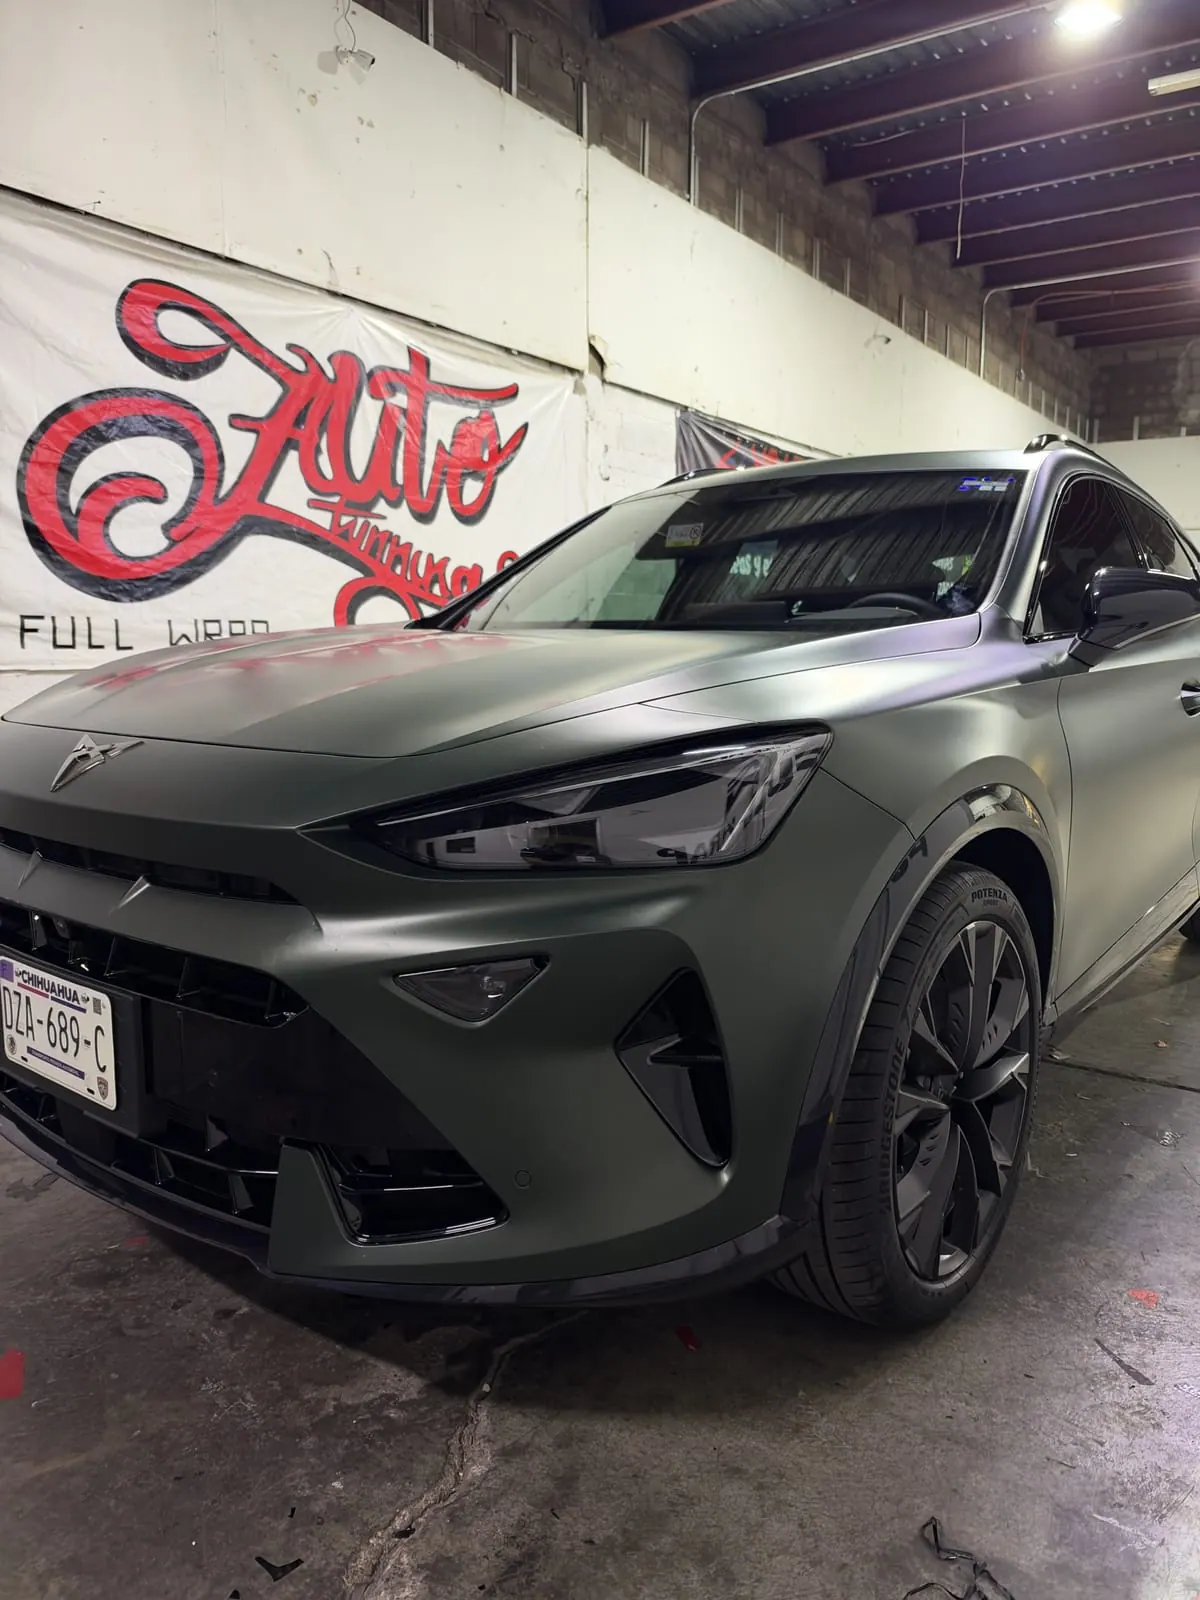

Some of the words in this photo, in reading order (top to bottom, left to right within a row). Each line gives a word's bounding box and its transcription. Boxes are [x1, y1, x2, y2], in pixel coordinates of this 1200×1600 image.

[20, 615, 133, 649] FULL
[971, 887, 1008, 903] POTENZA
[22, 970, 80, 1005] CHIHUAHUA
[3, 986, 107, 1073] DZA-689-C
